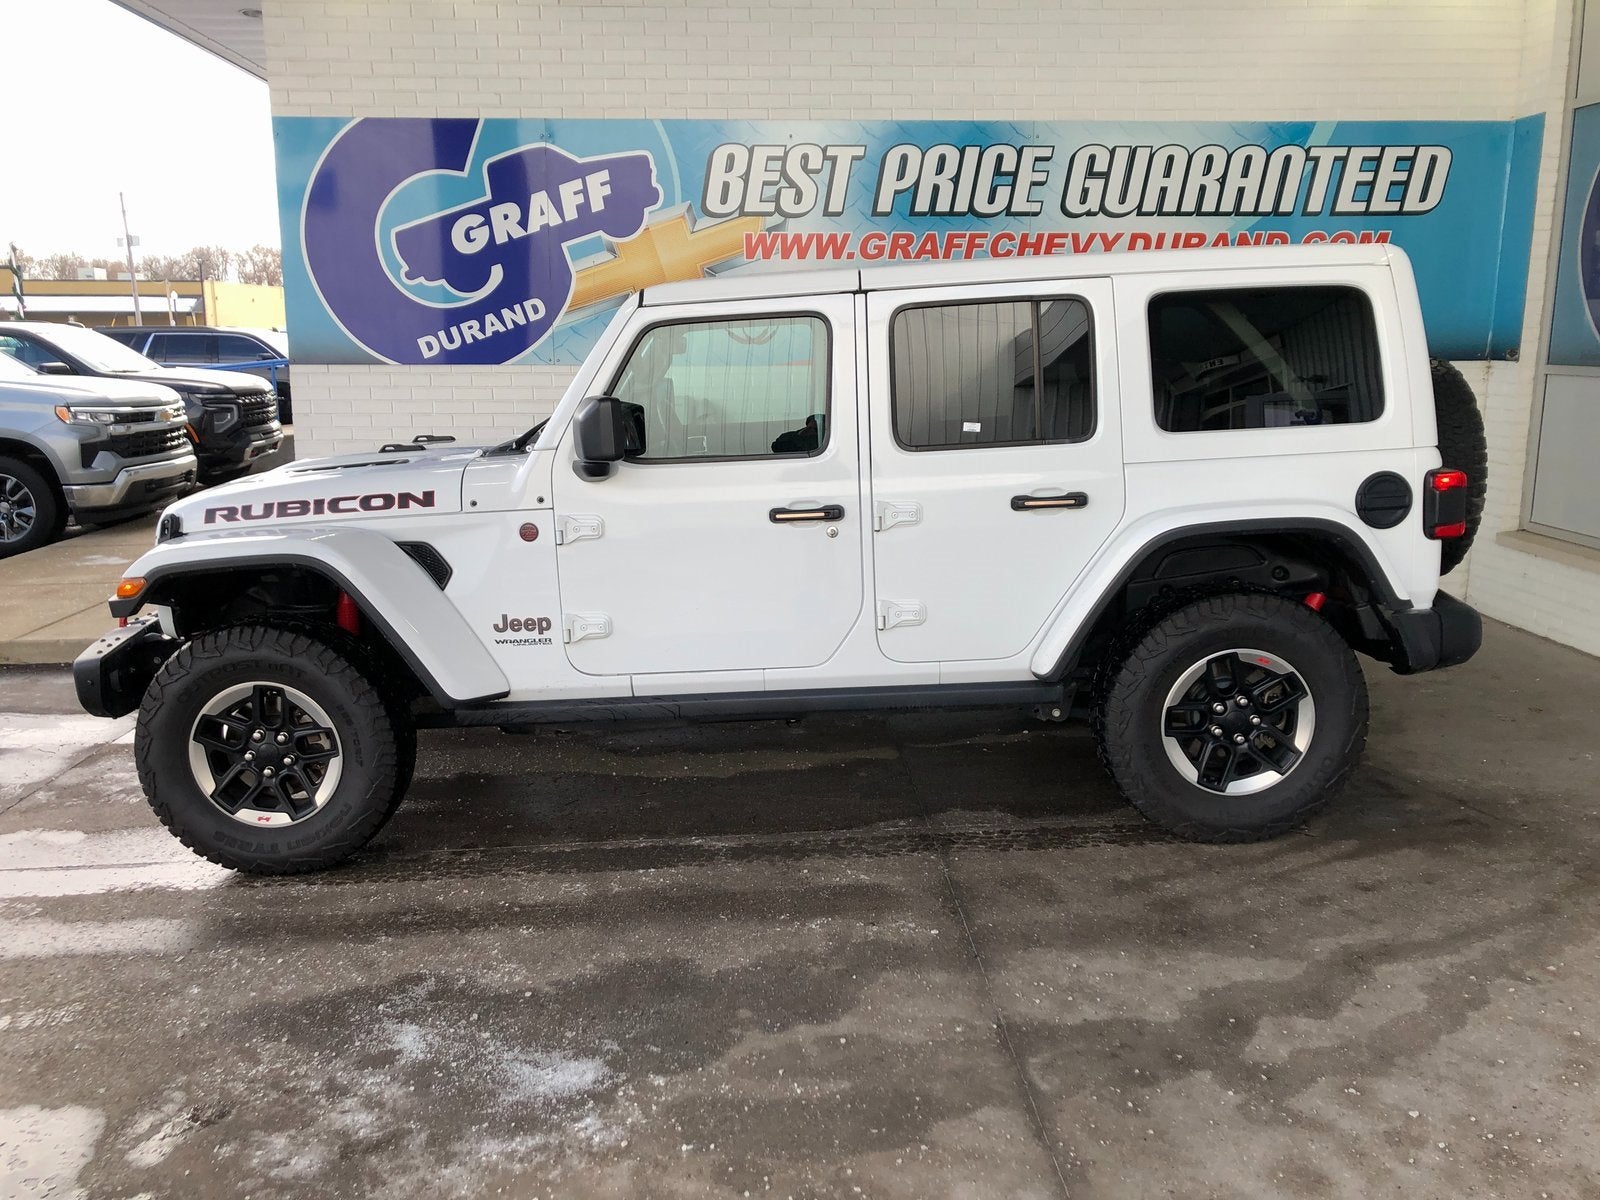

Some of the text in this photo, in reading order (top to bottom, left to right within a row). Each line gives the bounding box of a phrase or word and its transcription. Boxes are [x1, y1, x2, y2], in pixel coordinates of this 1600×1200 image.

[702, 142, 1453, 218] BEST PRICE GUARANTEED
[450, 168, 612, 255] GRAFF
[743, 231, 1392, 261] WWW.GRAFFCHEVYDURAN
[417, 297, 546, 359] DURAND
[204, 490, 435, 524] RUBICON
[493, 613, 552, 635] Jeep
